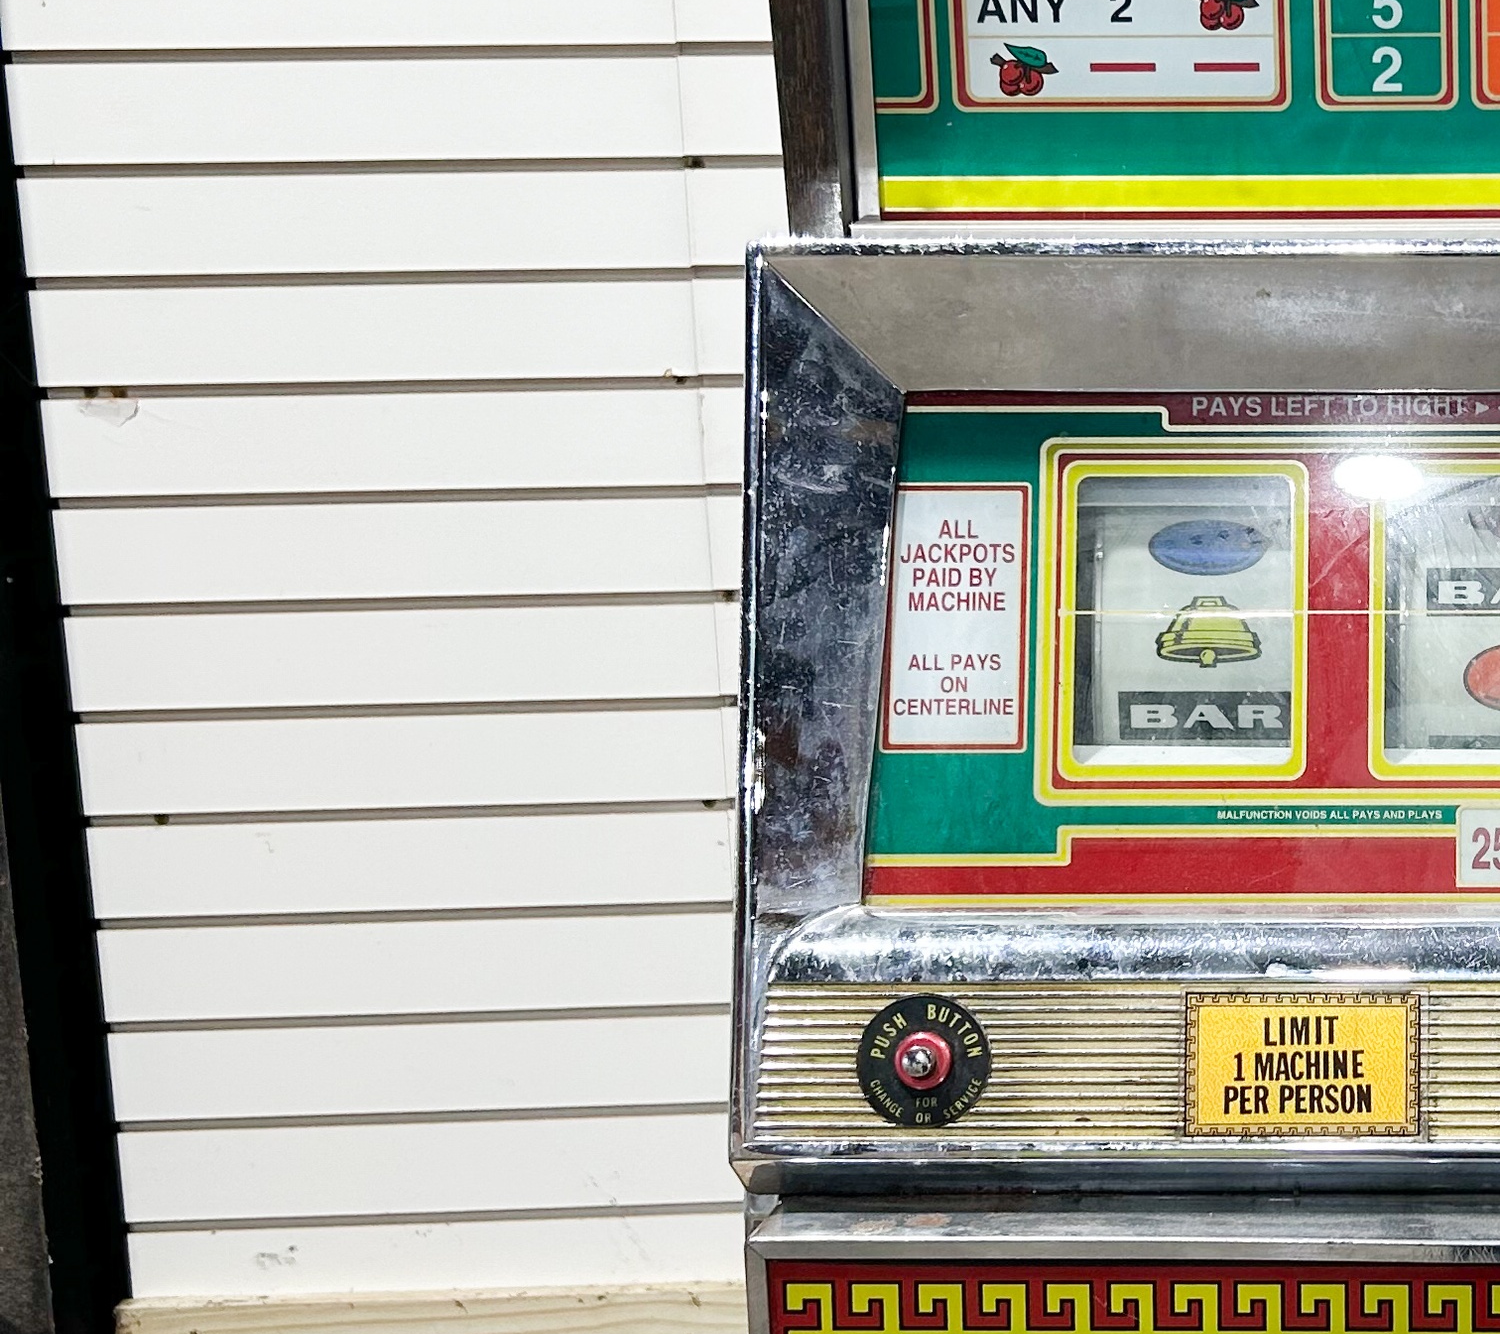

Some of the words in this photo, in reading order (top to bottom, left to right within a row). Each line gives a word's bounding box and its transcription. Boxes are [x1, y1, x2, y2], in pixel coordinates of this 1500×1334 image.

[1372, 46, 1403, 92] 2
[1192, 396, 1262, 417] PAYS
[1271, 395, 1338, 417] LEFT
[1343, 395, 1378, 416] TO
[1387, 395, 1468, 417] RIGHT
[938, 519, 979, 540] ALL
[900, 543, 1016, 564] JACKPOTS
[912, 567, 962, 587] PAID
[969, 567, 998, 587] BY
[907, 592, 1006, 612] MACHINE
[908, 654, 945, 671] ALL
[950, 654, 1002, 671] PAYS
[940, 676, 968, 693] ON
[893, 698, 1014, 716] CENTERLINE
[1129, 704, 1284, 732] BAR
[1217, 810, 1292, 820] MALFUNCTION
[1295, 810, 1327, 820] VOIDS
[1329, 810, 1349, 820] ALL
[1352, 810, 1380, 820] PAYS
[1383, 810, 1405, 820] AND
[1408, 810, 1443, 820] PLAYS
[870, 1012, 908, 1059] PUSH
[927, 1003, 983, 1059] BUTTON
[1264, 1015, 1339, 1047] LIMIT
[1233, 1052, 1245, 1082] 1
[1254, 1049, 1365, 1082] MACHINE
[870, 1079, 905, 1118] CHANGE
[915, 1112, 932, 1124] OR
[942, 1077, 982, 1118] SERVICE
[915, 1097, 938, 1108] FOR
[1223, 1085, 1270, 1116] PER
[1279, 1084, 1372, 1114] PERSON
